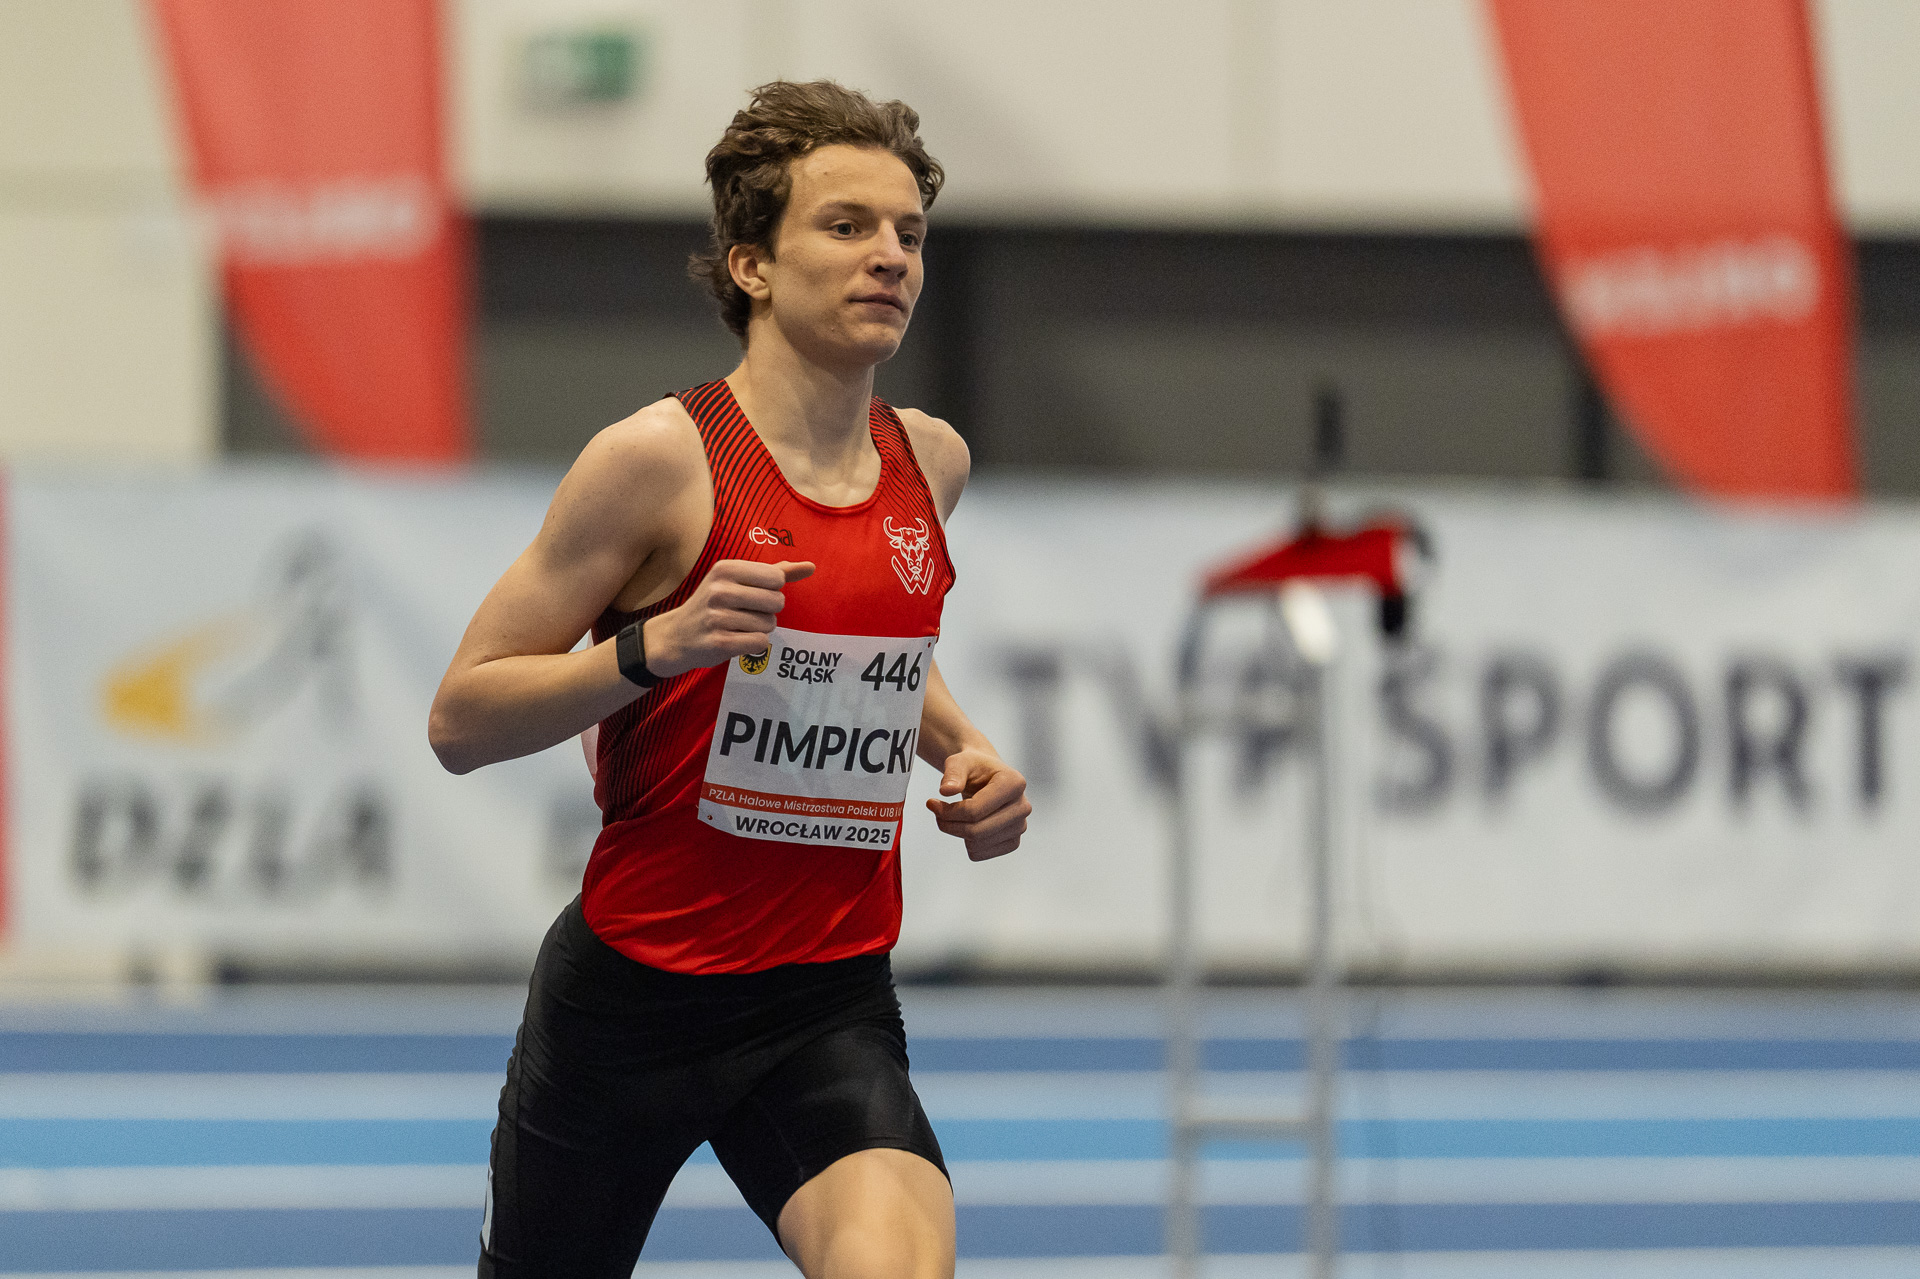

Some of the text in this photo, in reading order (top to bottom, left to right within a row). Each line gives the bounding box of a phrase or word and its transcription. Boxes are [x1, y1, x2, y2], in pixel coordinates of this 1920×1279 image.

[749, 526, 796, 547] esa
[776, 659, 836, 685] ŚLĄSK
[780, 647, 843, 667] DOLNY
[860, 651, 923, 692] 446
[719, 711, 917, 774] PIMPICKI
[1374, 645, 1914, 818] SPORT
[708, 788, 736, 803] PZLA
[739, 793, 782, 810] Halowe
[783, 799, 845, 815] Mistrzostwa
[847, 804, 878, 817] Polski
[879, 807, 895, 818] U18
[735, 814, 892, 845] WROCŁAW 2025
